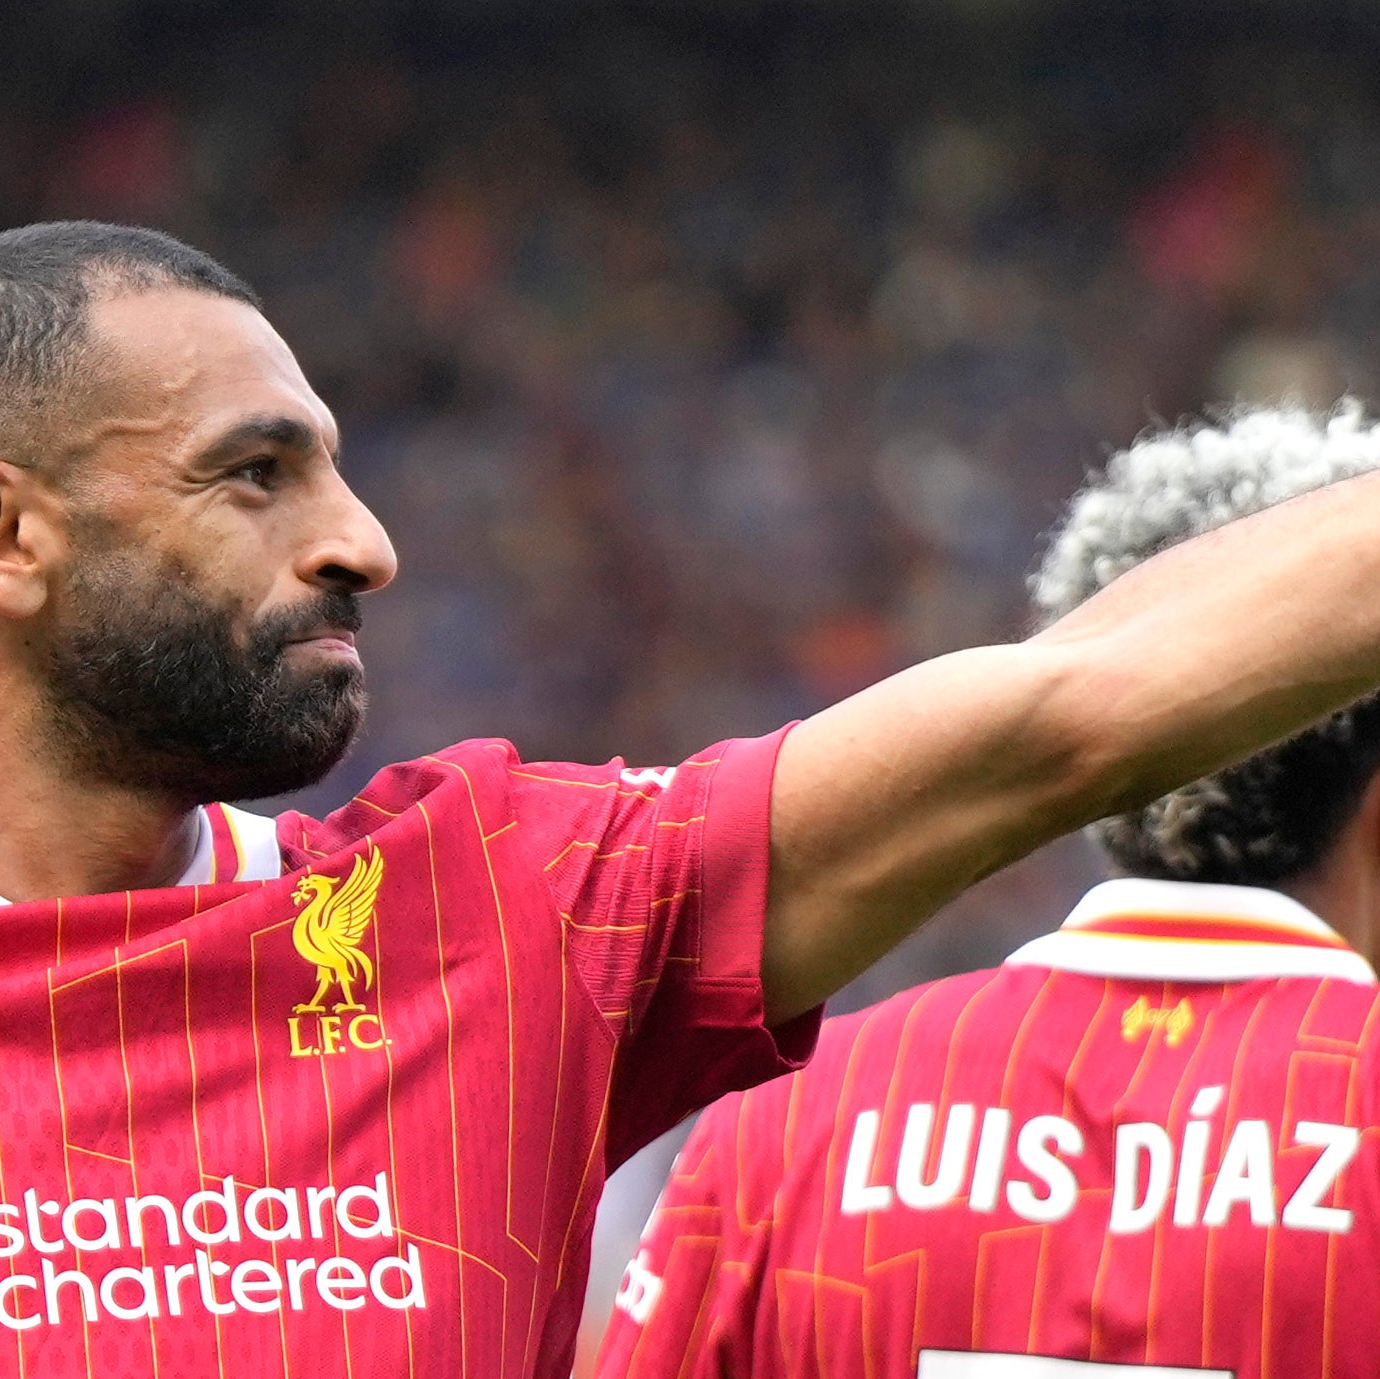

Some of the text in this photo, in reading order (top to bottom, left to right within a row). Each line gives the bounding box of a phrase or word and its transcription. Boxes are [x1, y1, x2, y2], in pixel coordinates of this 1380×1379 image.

[287, 1013, 393, 1057] L.F.C.
[838, 1083, 1363, 1236] LUIS DÍAZ
